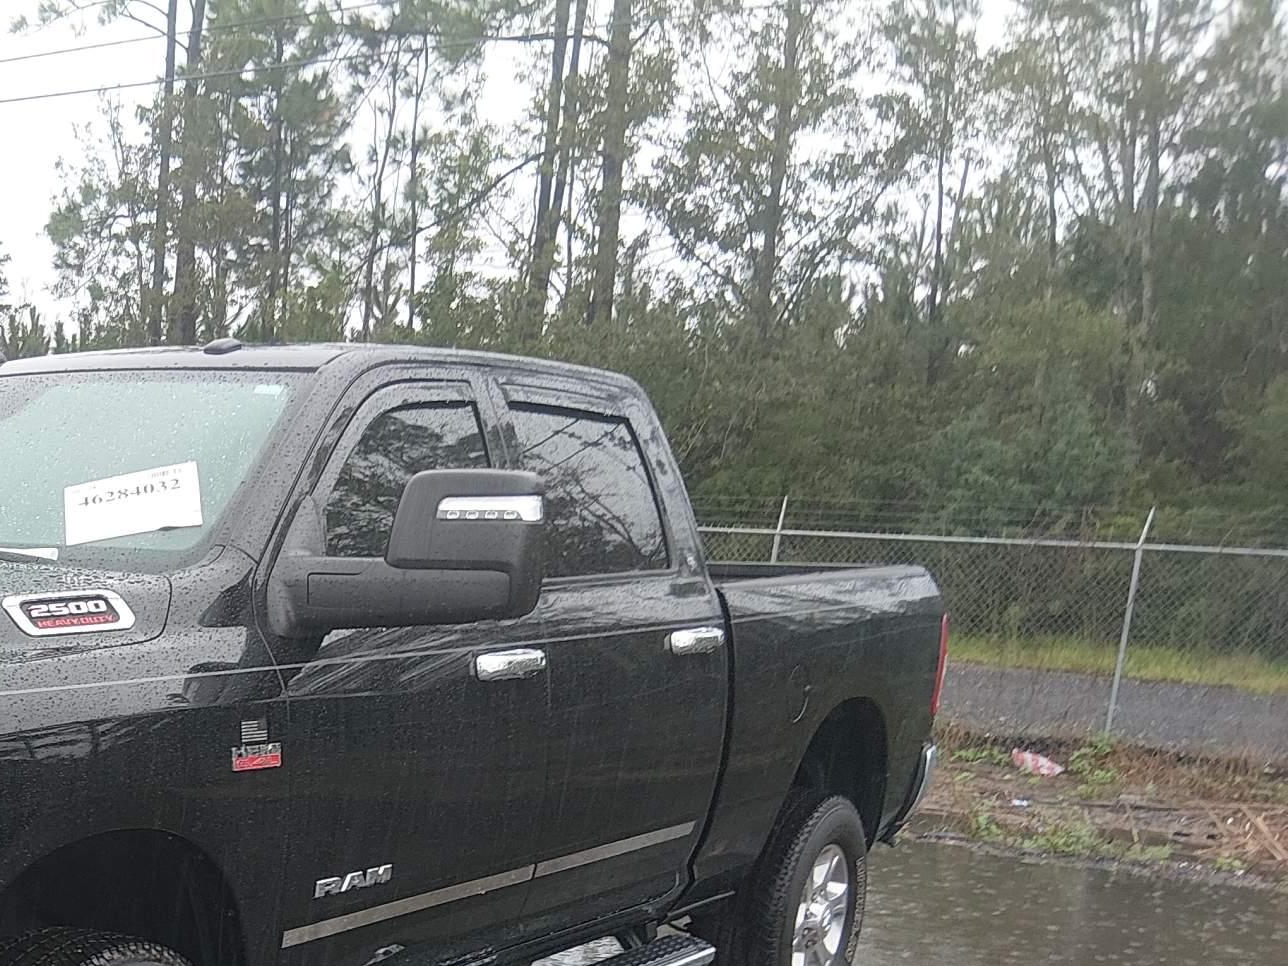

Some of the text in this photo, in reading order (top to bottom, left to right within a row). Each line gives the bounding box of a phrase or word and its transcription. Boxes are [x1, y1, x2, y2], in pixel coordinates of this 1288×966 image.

[78, 479, 181, 506] 46284032
[28, 600, 108, 618] 2500
[37, 614, 113, 628] HEAVY DUTY
[314, 863, 393, 898] RAM
